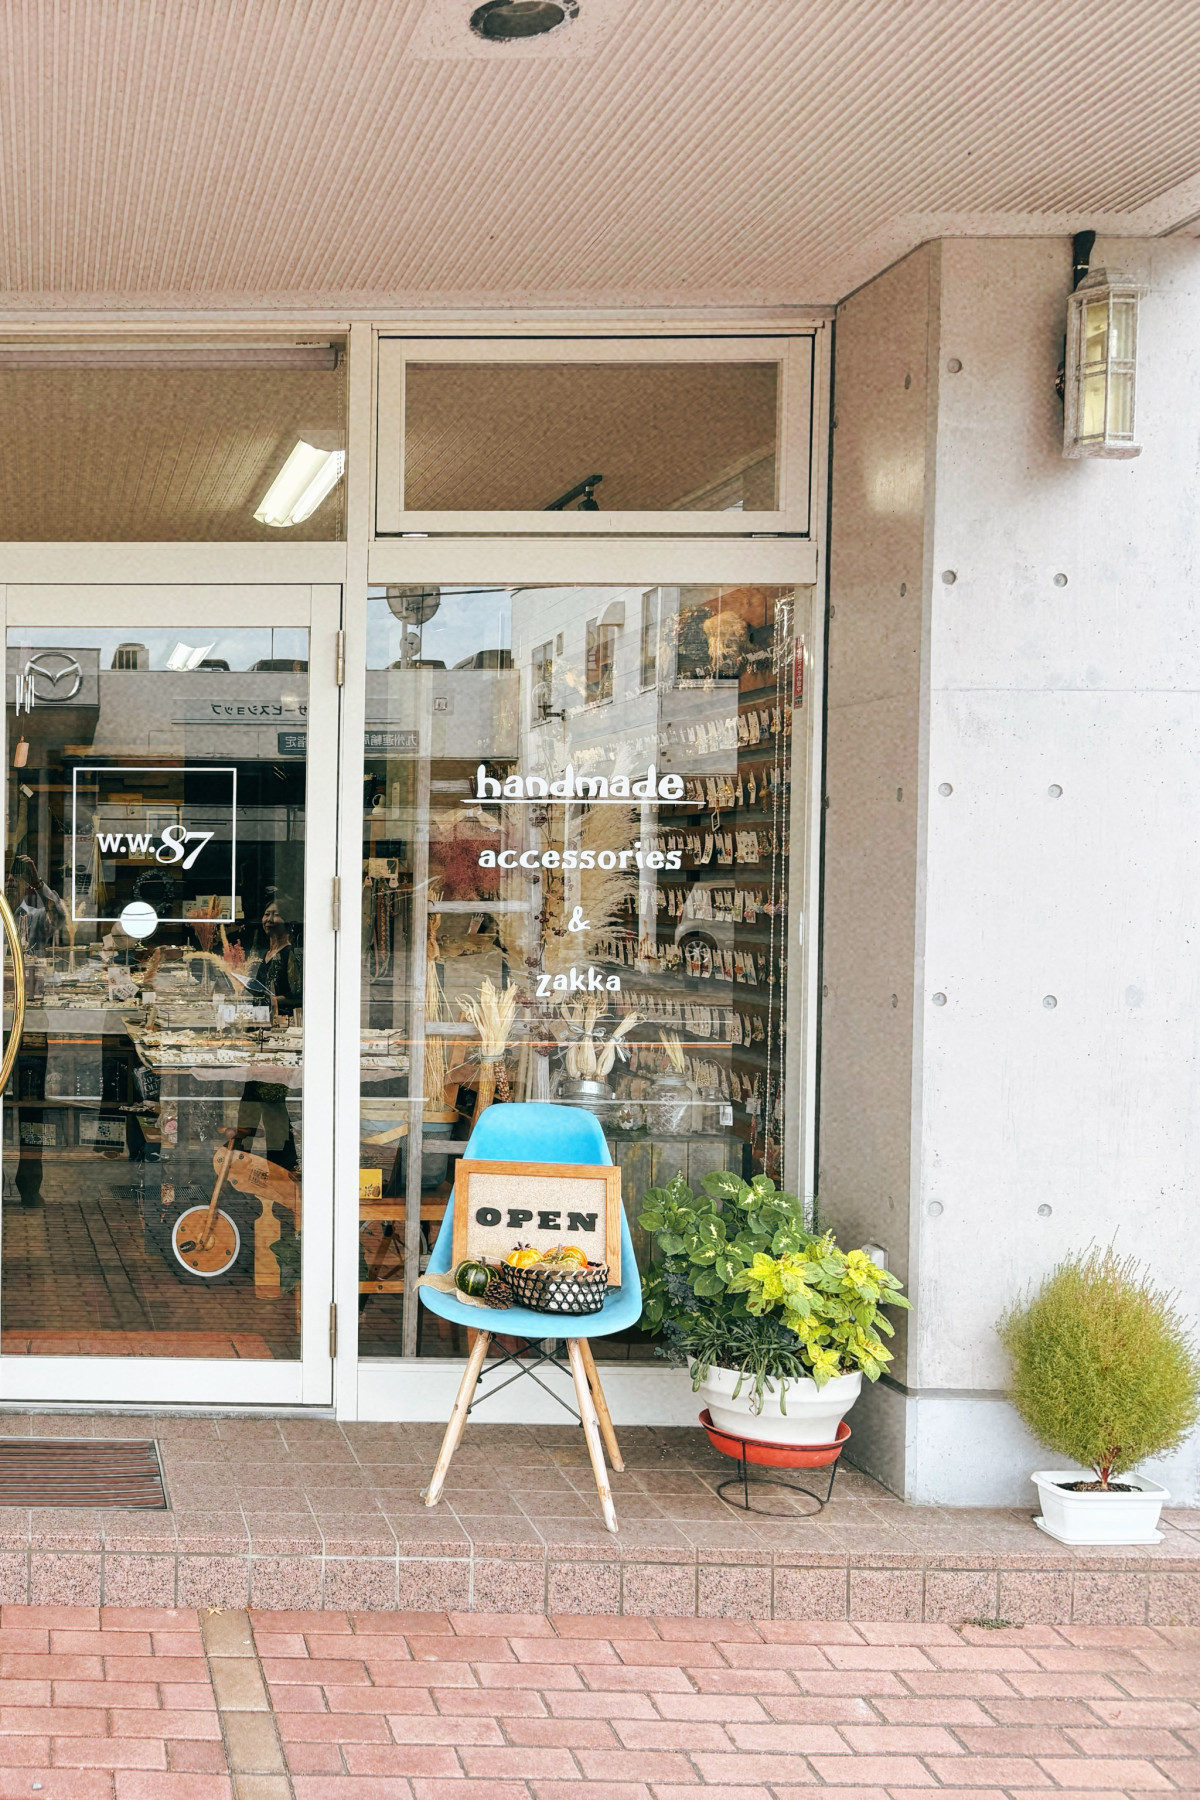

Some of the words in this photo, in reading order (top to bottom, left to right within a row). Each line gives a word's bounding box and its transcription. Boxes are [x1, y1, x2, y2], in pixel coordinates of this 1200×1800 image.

[476, 763, 685, 799] handmade
[478, 842, 682, 870] accessories
[567, 906, 591, 933] &
[536, 966, 622, 997] zakka
[475, 1206, 598, 1232] OPEN
